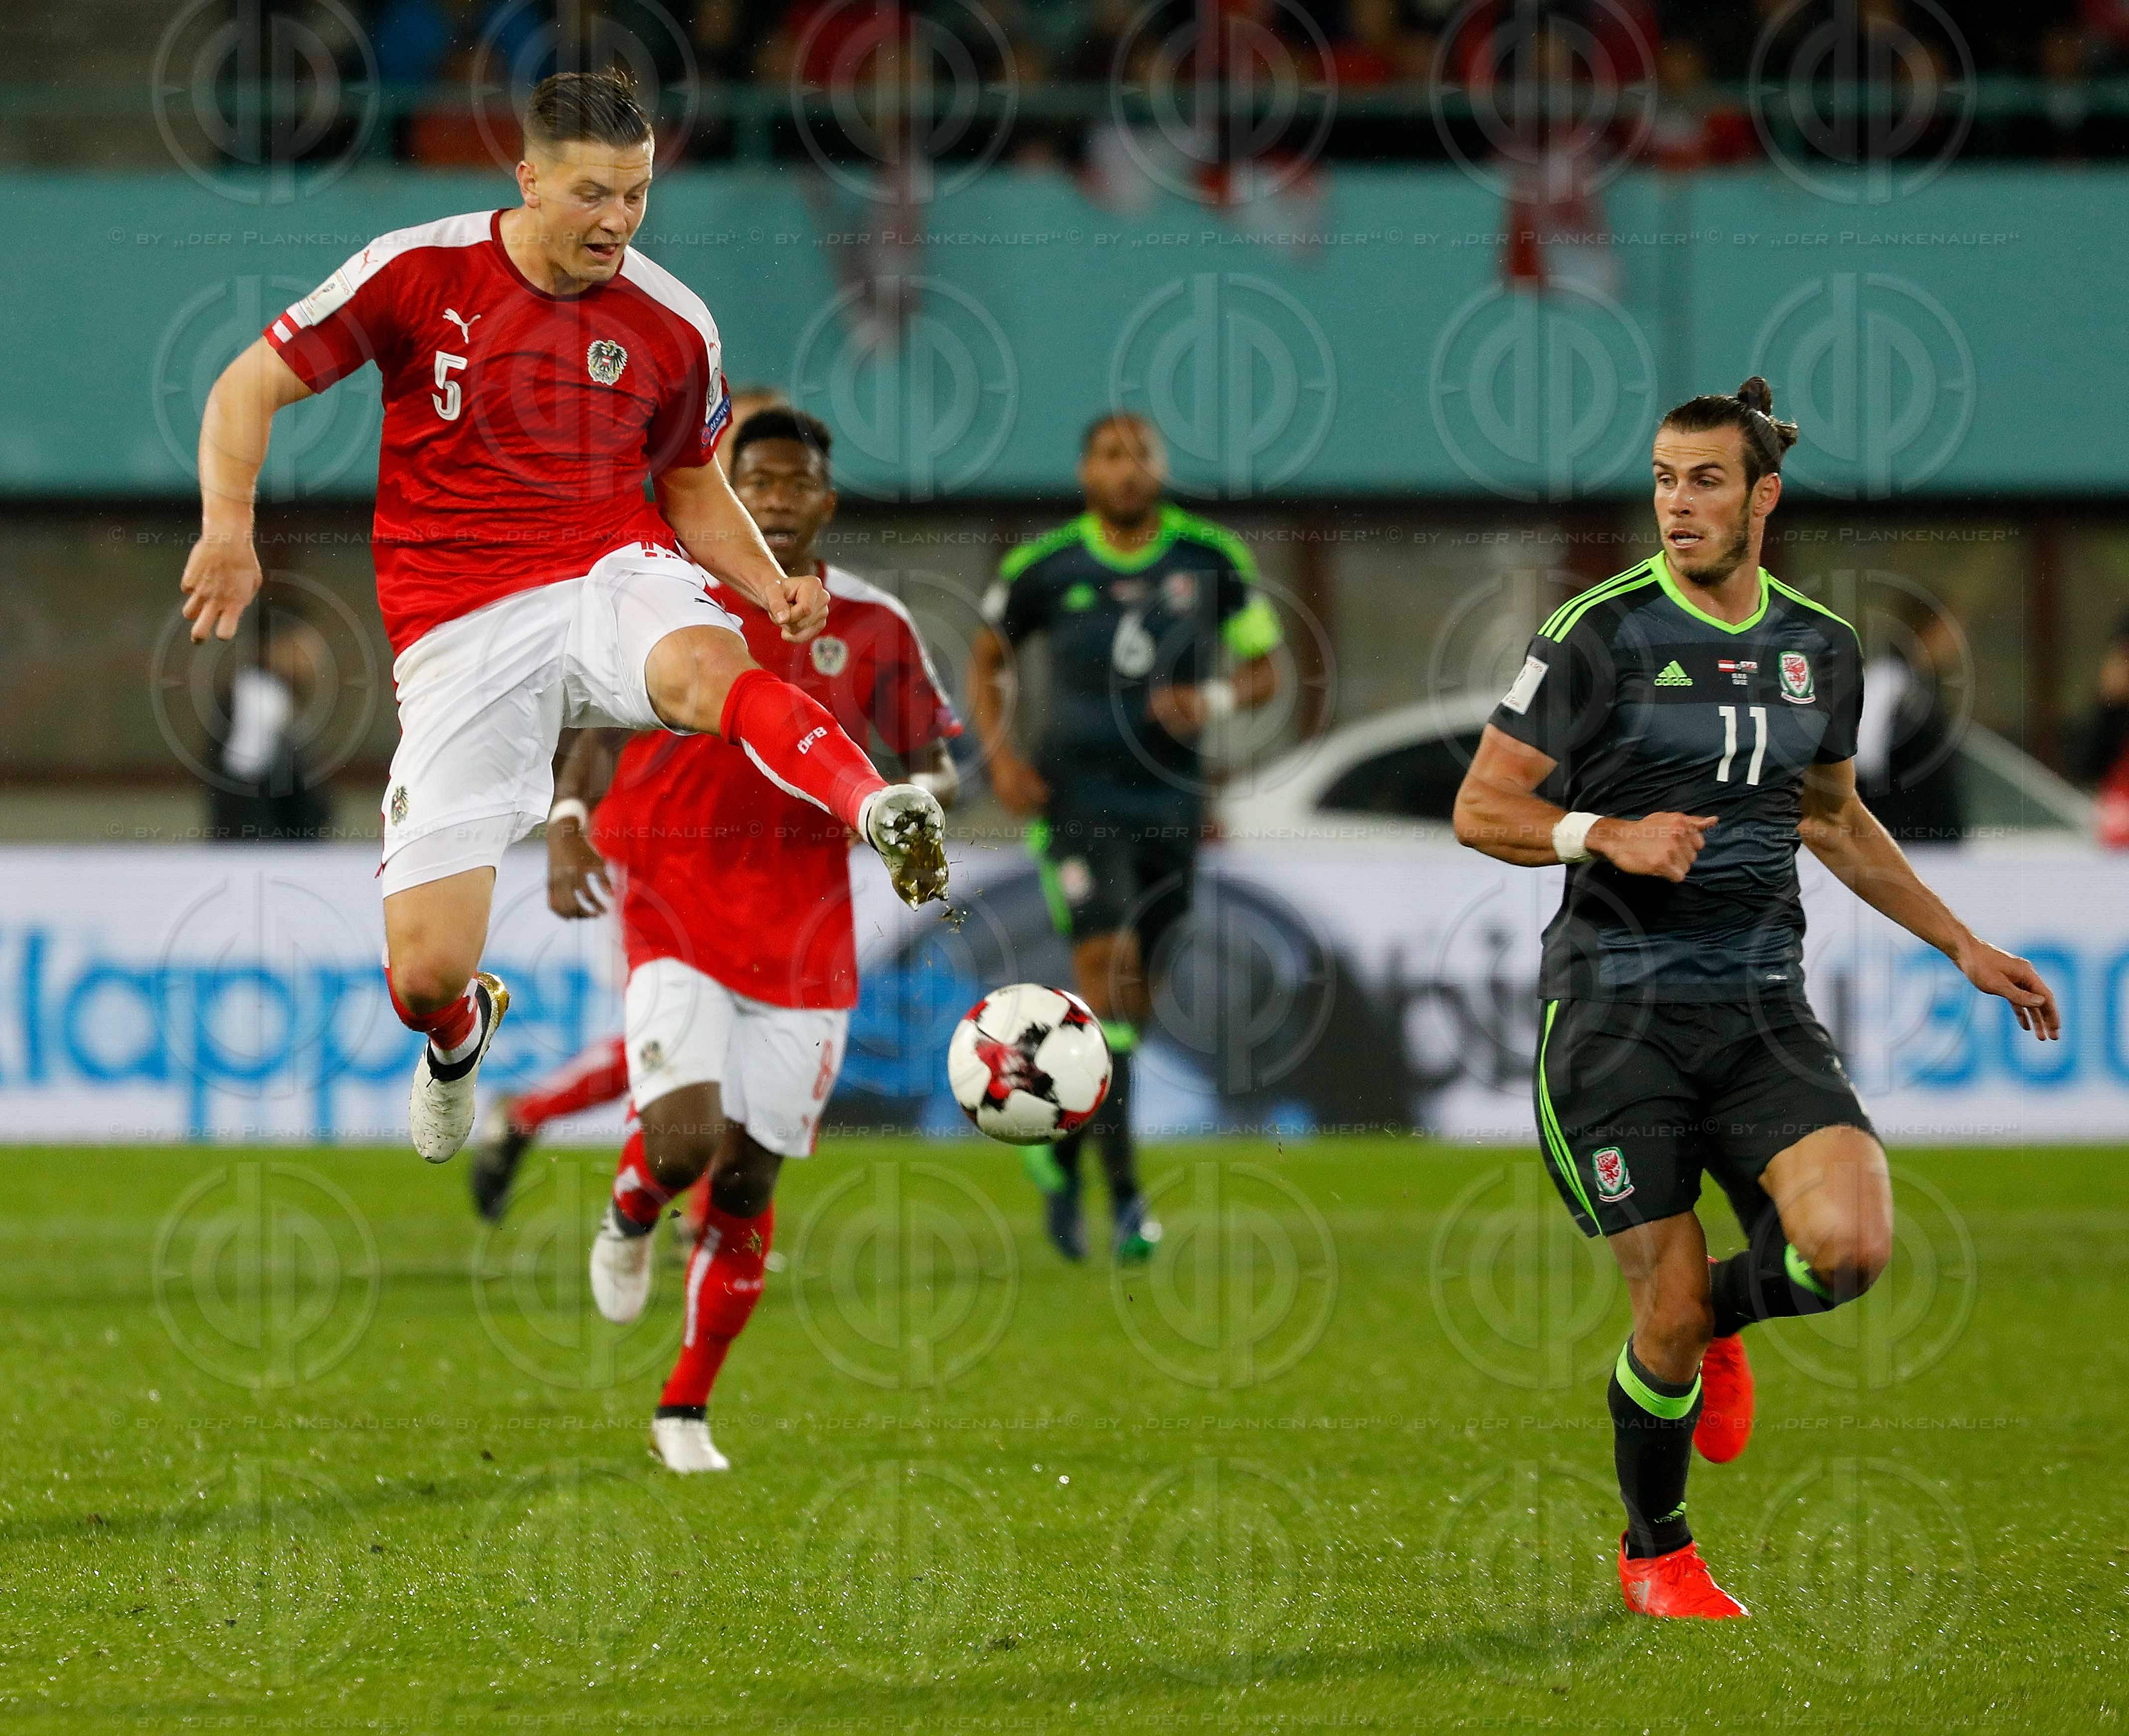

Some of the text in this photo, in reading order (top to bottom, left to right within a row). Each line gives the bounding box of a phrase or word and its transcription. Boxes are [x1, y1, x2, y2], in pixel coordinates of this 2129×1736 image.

[432, 350, 468, 422] 5
[1111, 610, 1157, 678] 6
[1653, 678, 1694, 686] adidas
[1716, 706, 1768, 786] 11
